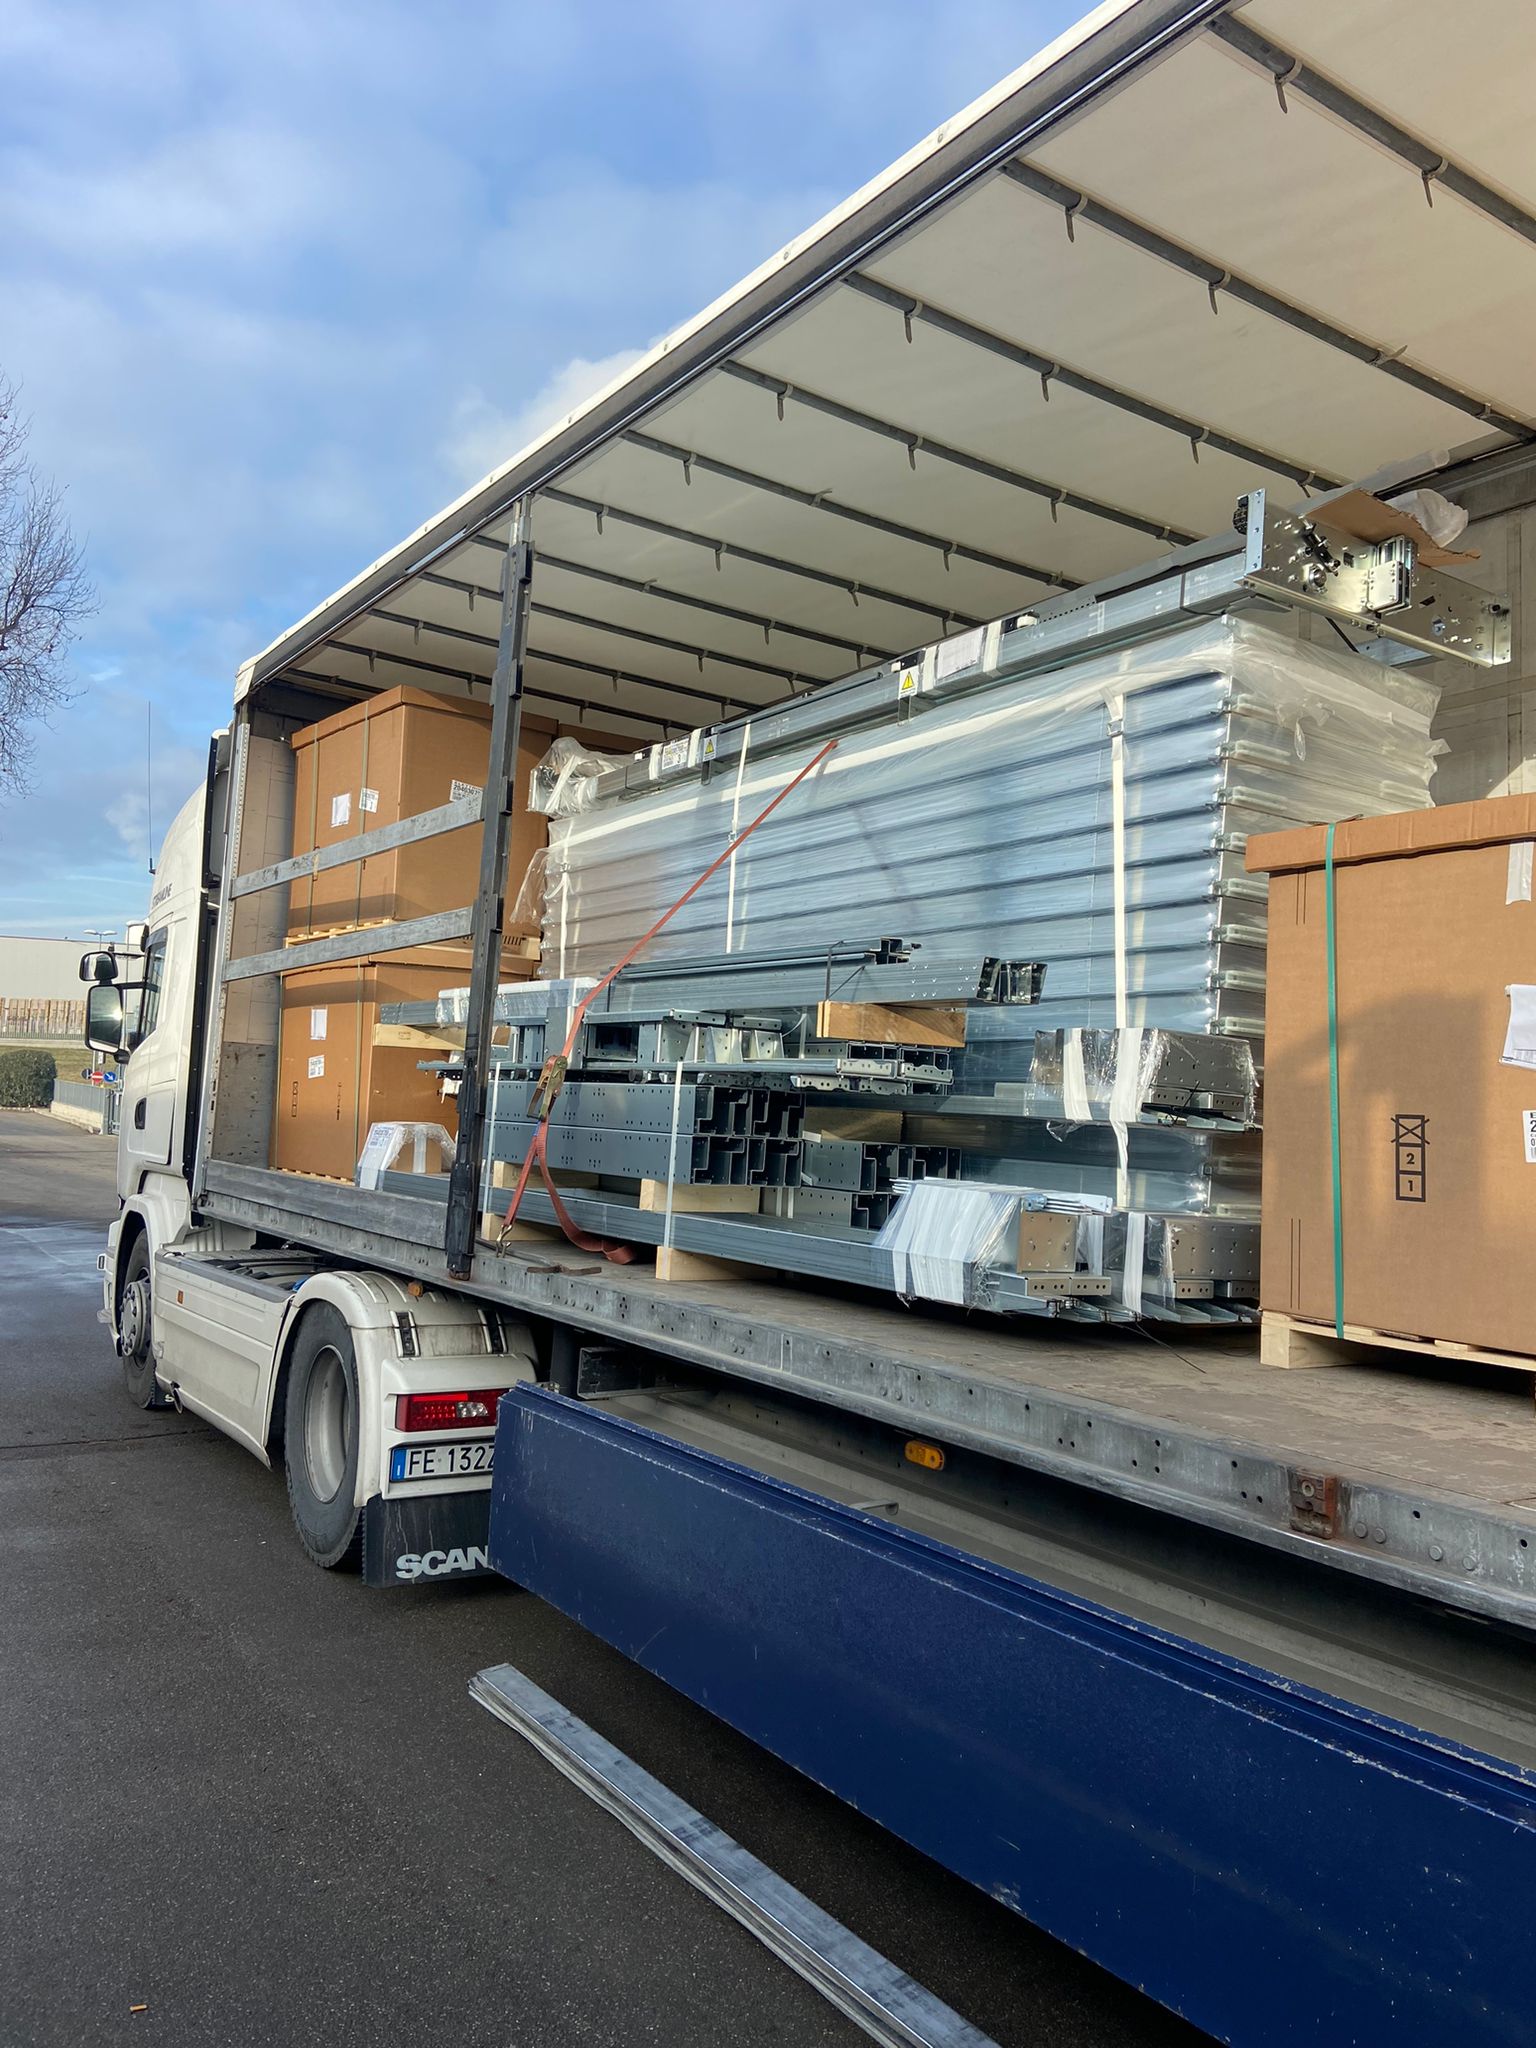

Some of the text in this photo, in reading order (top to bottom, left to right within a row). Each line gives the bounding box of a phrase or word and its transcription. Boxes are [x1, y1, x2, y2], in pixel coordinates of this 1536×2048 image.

[1406, 1152, 1415, 1165] 2
[1408, 1180, 1414, 1192] 1
[408, 1444, 495, 1475] FE 132Z
[395, 1544, 489, 1579] SCAN
